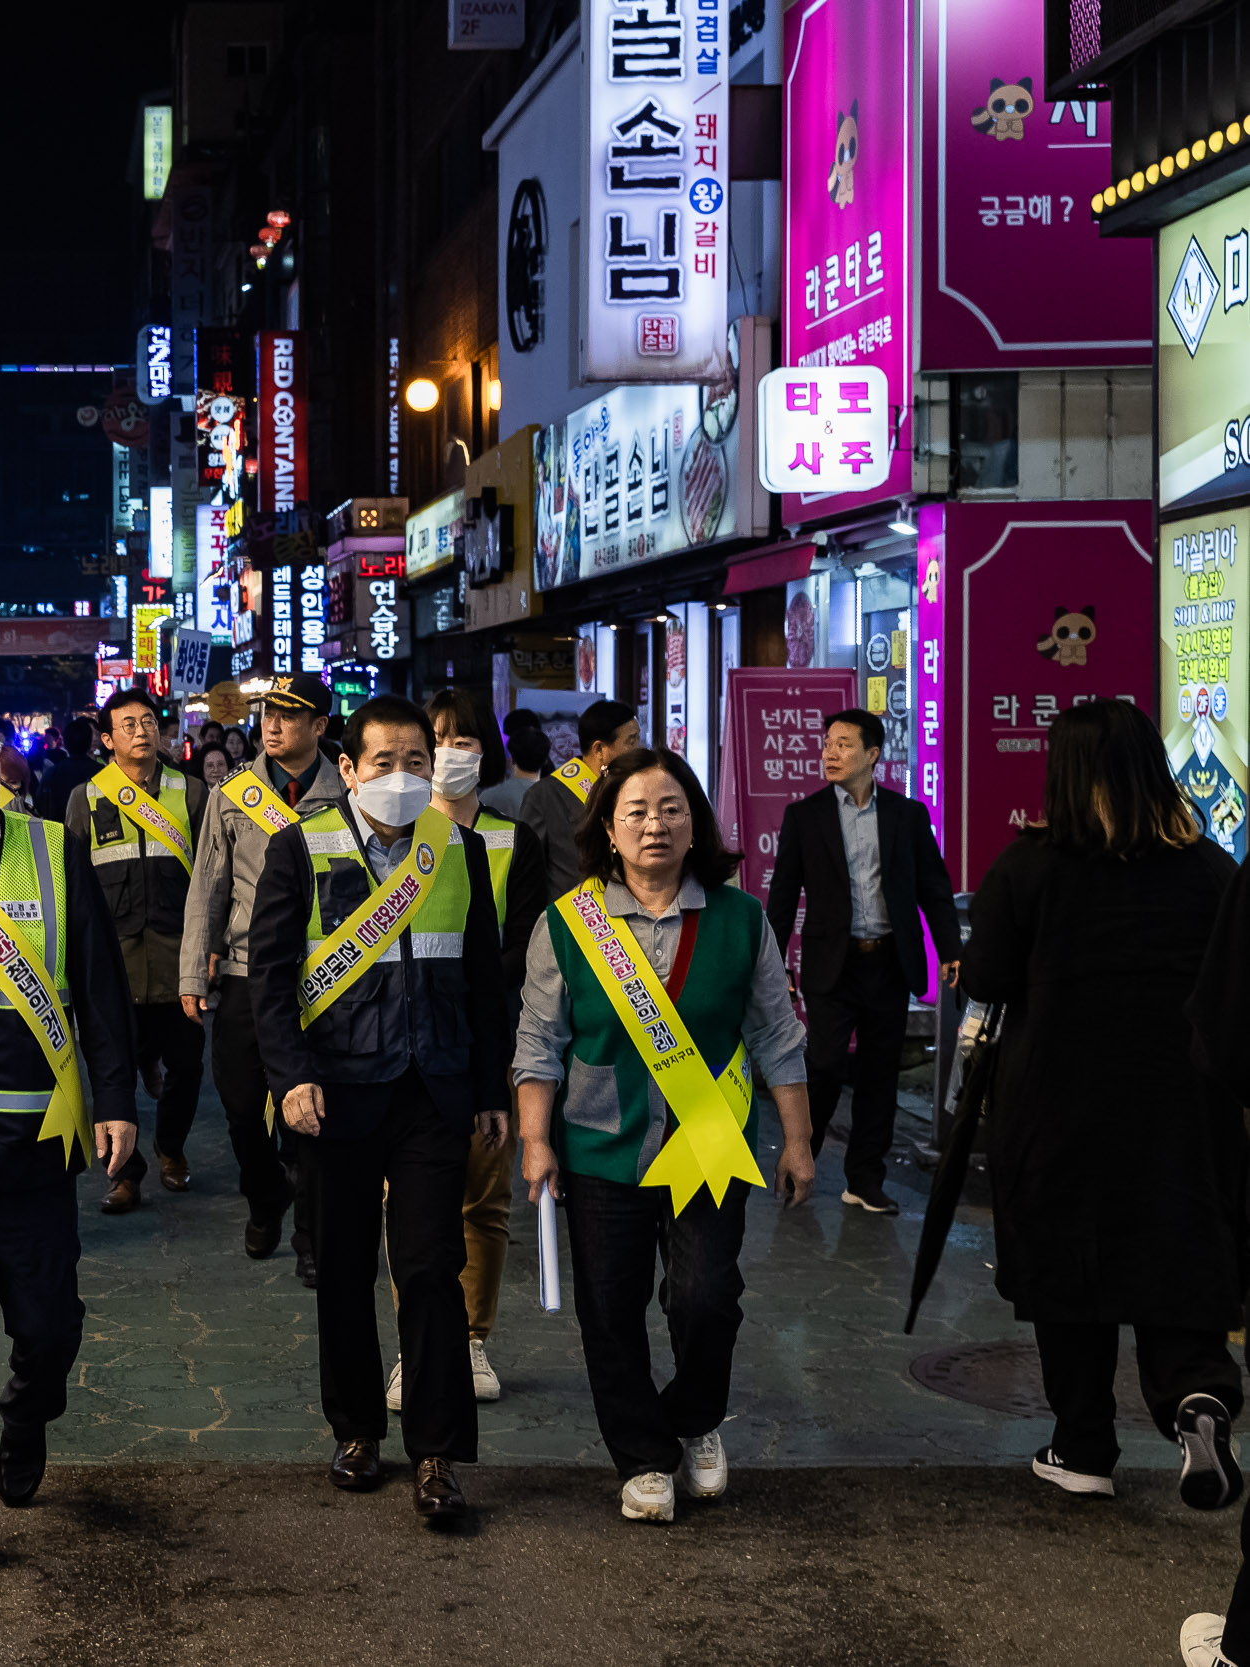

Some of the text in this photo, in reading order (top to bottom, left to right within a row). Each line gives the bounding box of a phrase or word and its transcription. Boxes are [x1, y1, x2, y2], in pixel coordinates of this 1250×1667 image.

[460, 20, 480, 35] 2F
[805, 230, 884, 319] 라쿤타로
[273, 338, 294, 388] RED
[785, 381, 873, 416] 타로
[118, 445, 132, 514] FEE Lab
[583, 426, 669, 539] 단골손님
[788, 441, 874, 475] 사주
[1173, 524, 1238, 575] 마실리아
[272, 565, 292, 673] 레드컨테이너
[300, 565, 326, 673] 성인용품
[368, 579, 400, 660] 연습장
[1174, 599, 1236, 628] SOJU & HOF
[1176, 625, 1233, 657] 24시간영업
[1178, 655, 1230, 686] 단체석완비
[761, 708, 824, 731] 넌지금
[1213, 693, 1226, 712] 3F
[923, 638, 940, 836] 라쿤타
[355, 872, 421, 950] 범죄없는
[570, 888, 678, 1055] 안전하고 건전한 청년의 거리
[4, 956, 54, 1018] 청년의
[41, 1007, 69, 1053] 거리
[653, 1047, 696, 1073] 화양지구대
